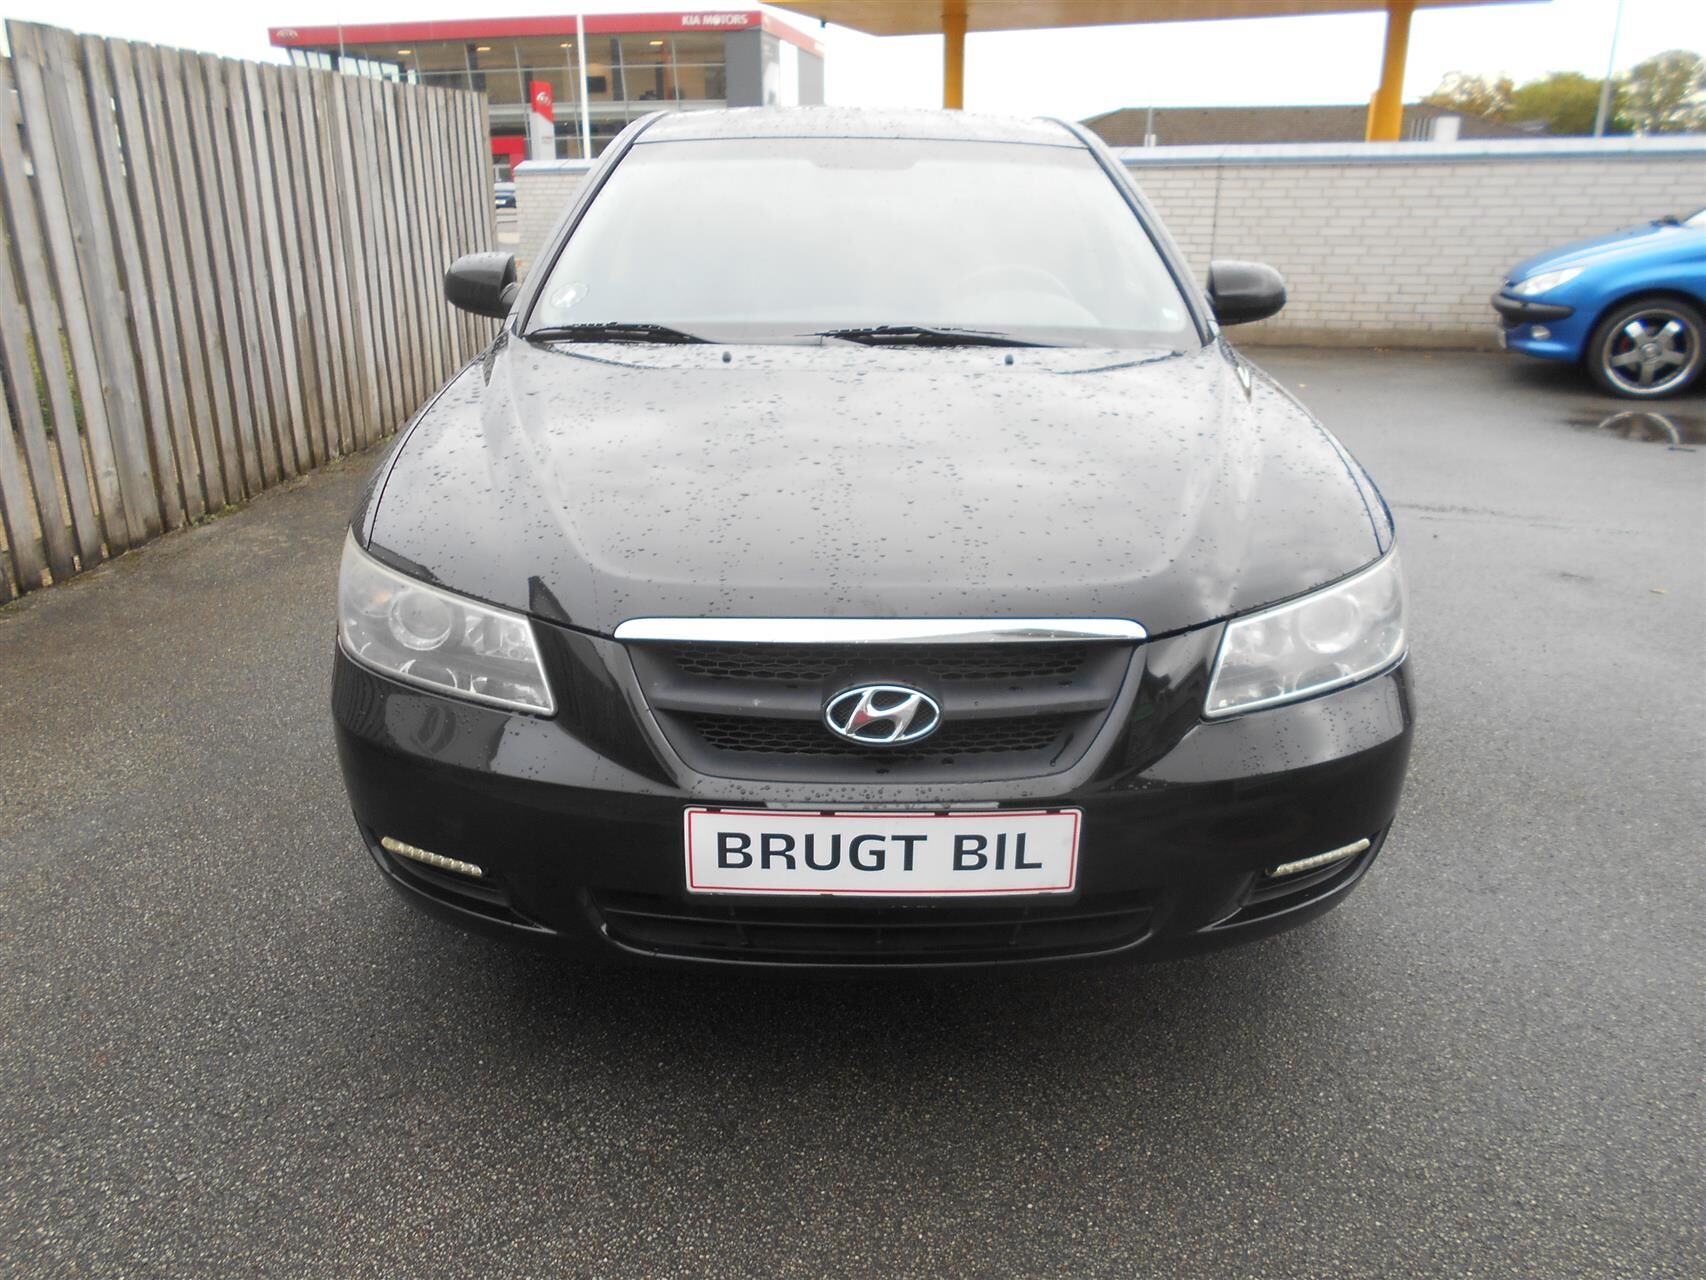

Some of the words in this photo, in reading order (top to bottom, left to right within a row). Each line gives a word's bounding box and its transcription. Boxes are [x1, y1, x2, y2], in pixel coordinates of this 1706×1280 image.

[682, 15, 700, 25] KIA
[702, 14, 748, 25] MOTORS
[717, 832, 928, 871] BRUGT
[953, 832, 1042, 871] BIL
